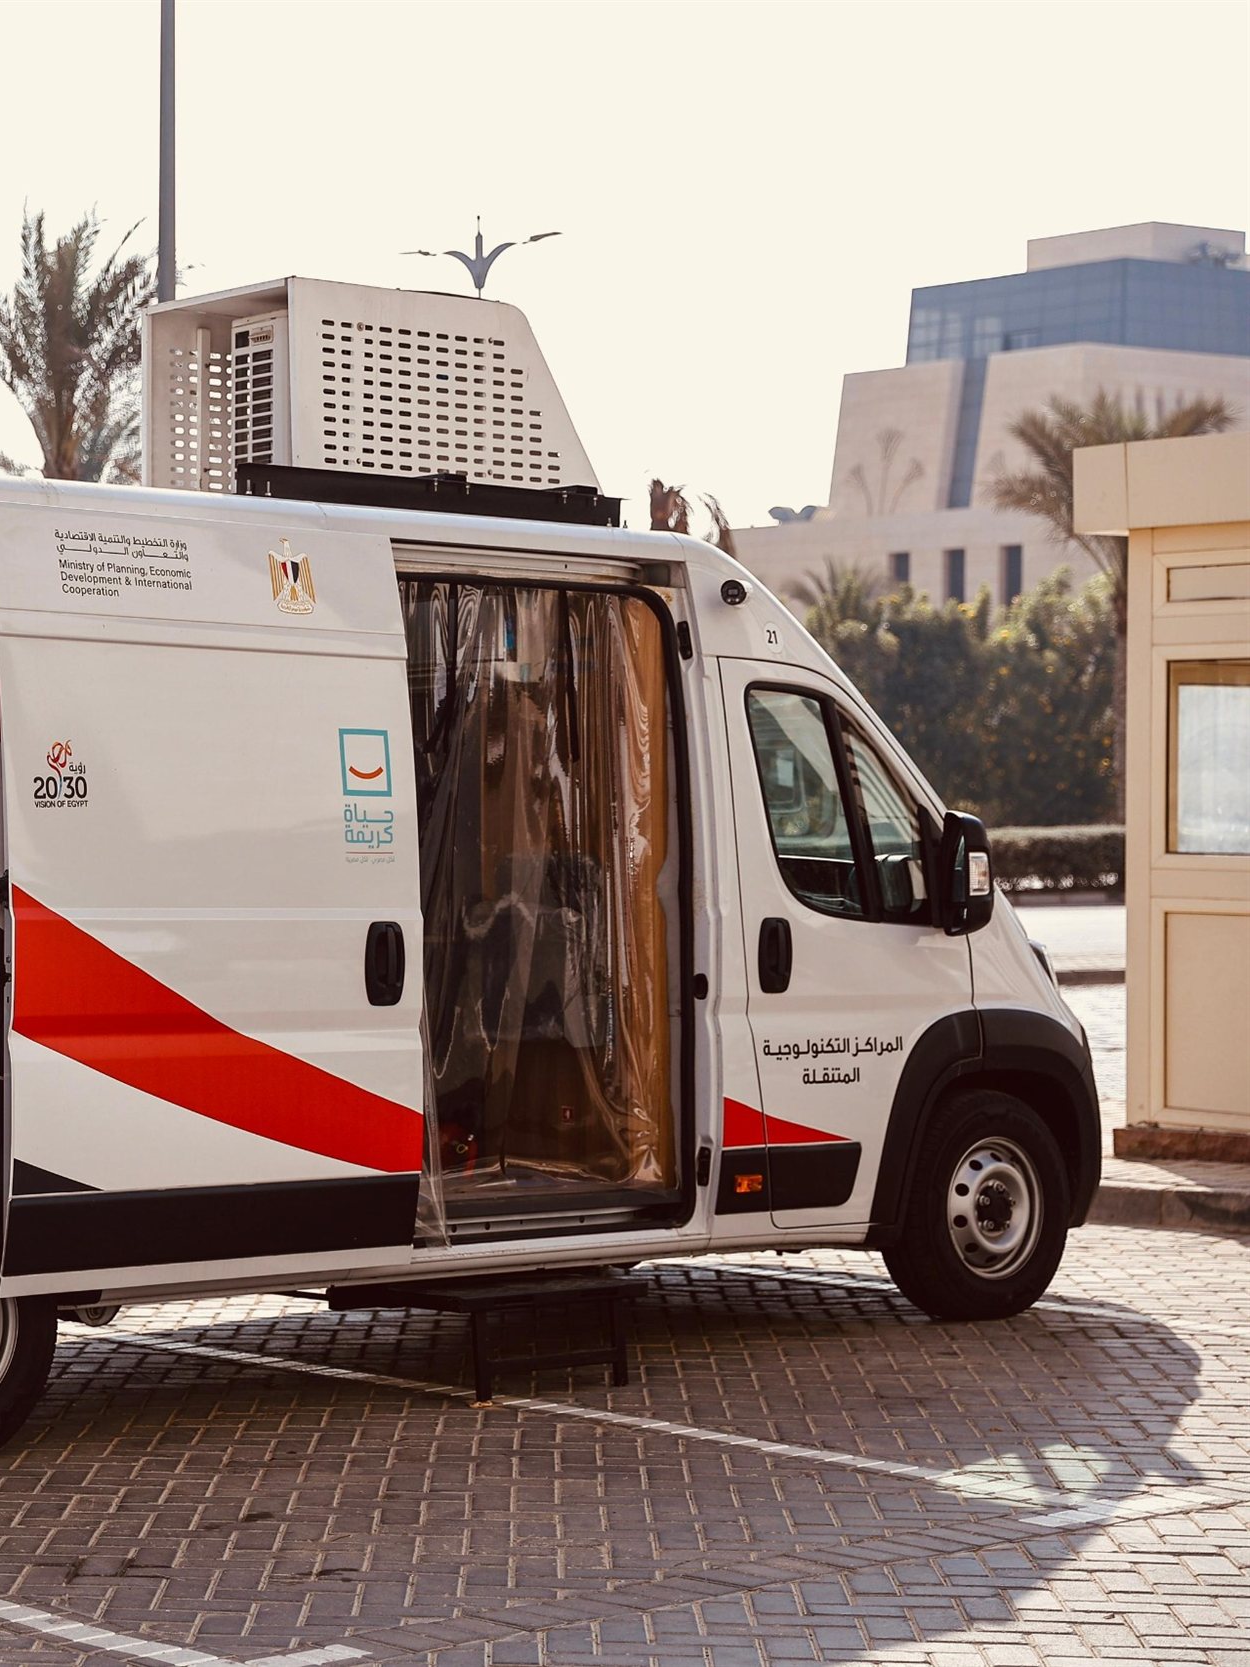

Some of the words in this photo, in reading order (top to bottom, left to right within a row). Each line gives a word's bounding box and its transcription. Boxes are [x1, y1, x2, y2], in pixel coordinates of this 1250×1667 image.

[54, 528, 97, 542] الاقتصادية
[97, 532, 131, 546] والتنمية
[132, 536, 168, 549] التخطيط
[169, 538, 188, 551] وزارة
[58, 558, 95, 574] Ministry
[96, 561, 105, 572] of
[106, 562, 148, 577] Planning,
[149, 565, 192, 579] Economic
[60, 570, 123, 586] Development
[124, 575, 133, 587] &
[134, 576, 193, 591] International
[61, 583, 120, 597] Cooperation
[766, 629, 778, 645] 21
[33, 776, 88, 800] 2030
[34, 800, 56, 808] VISION
[56, 800, 66, 808] OF
[66, 800, 89, 808] EGYPT
[343, 802, 394, 823] حياة
[345, 824, 393, 849] كريمة
[763, 1037, 850, 1061] التكنولوجية
[852, 1036, 903, 1057] المراكز
[802, 1067, 860, 1084] المتنقلة
